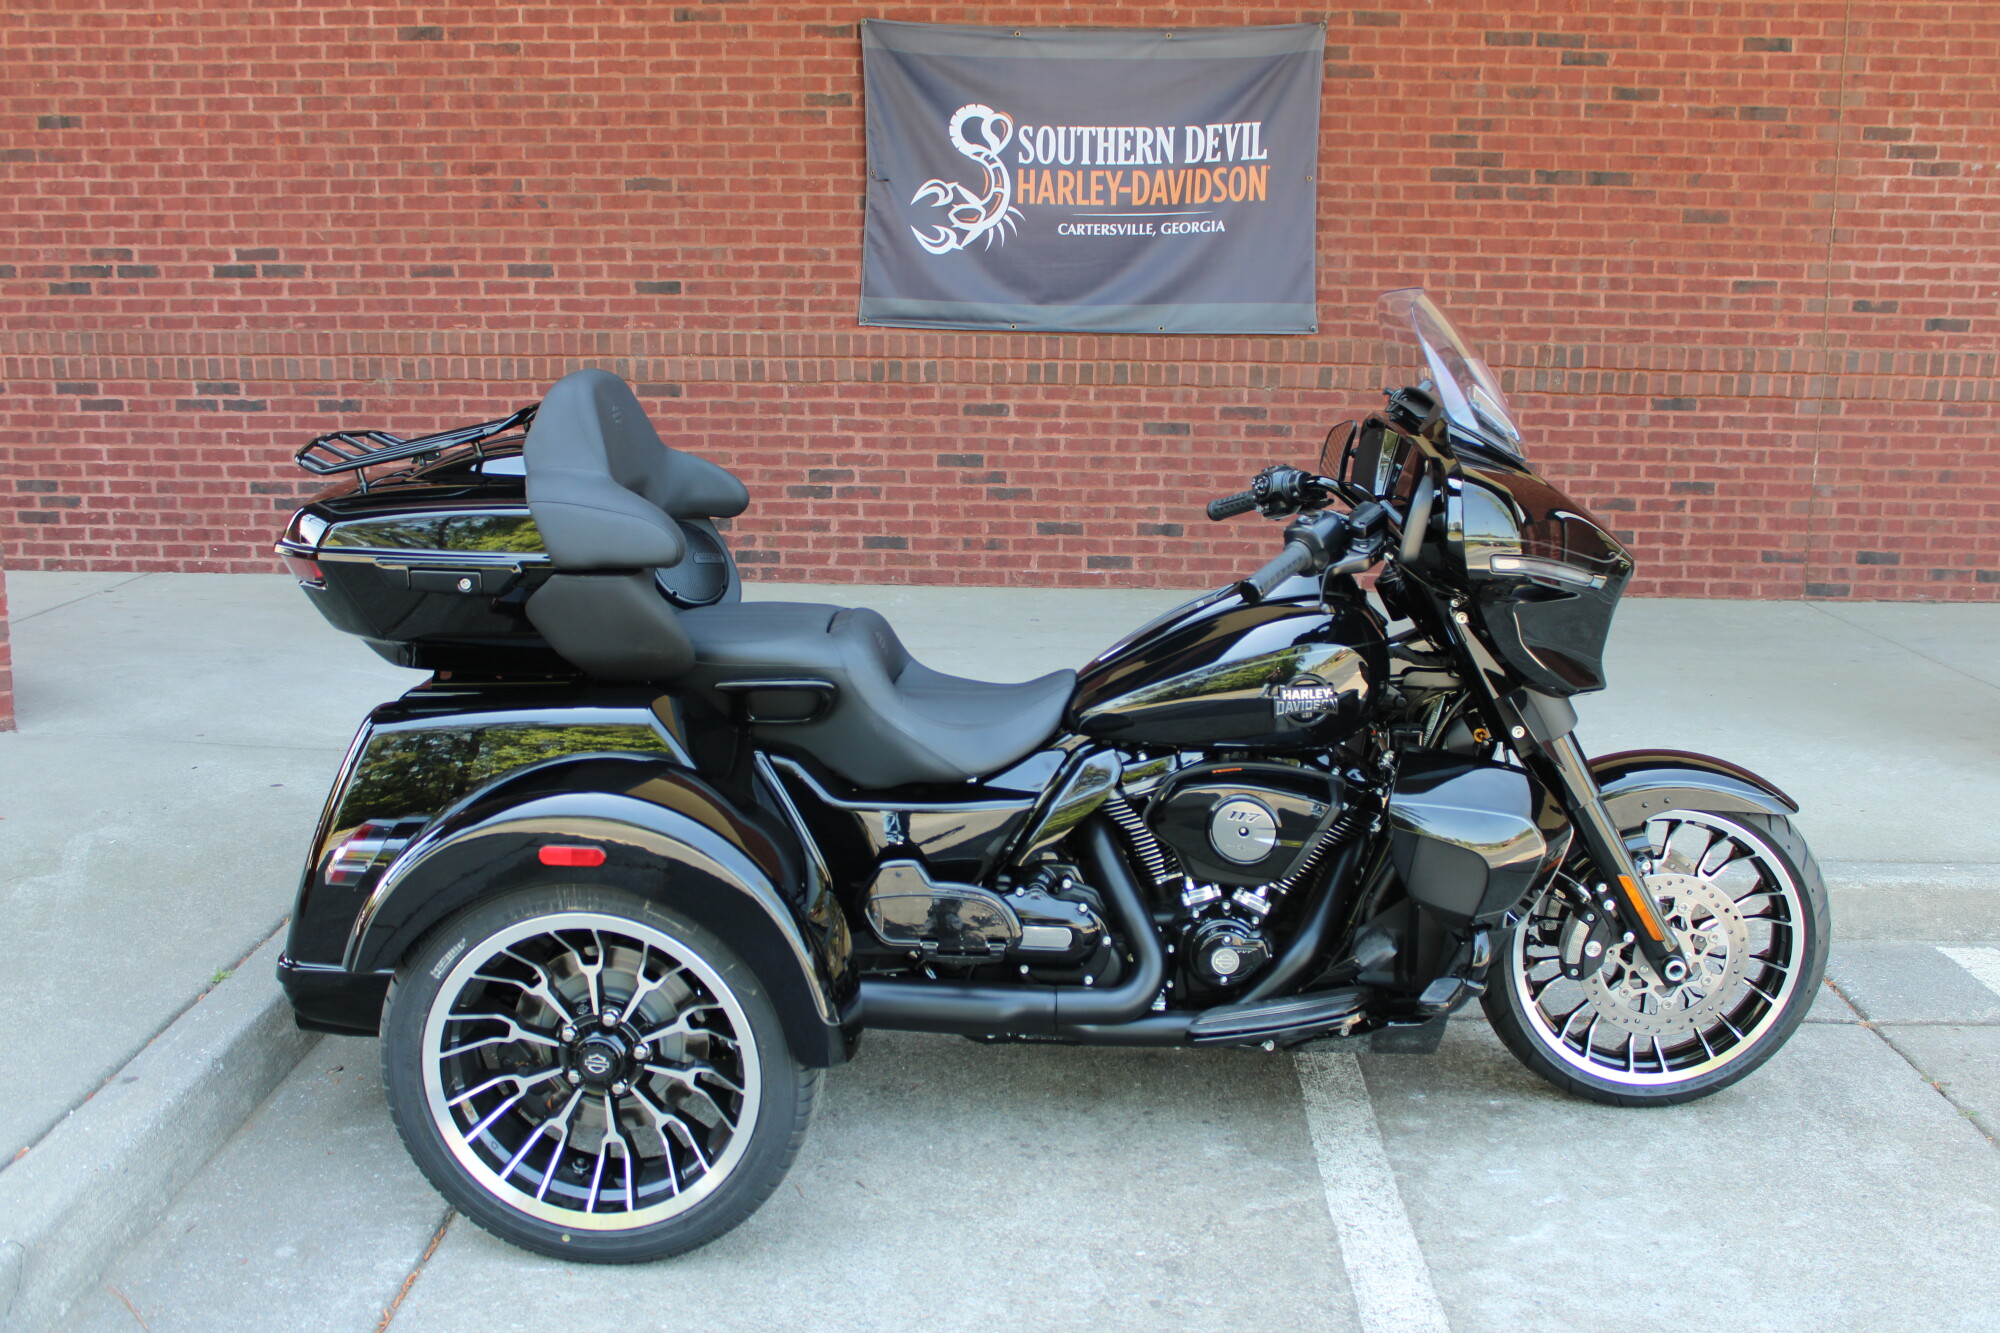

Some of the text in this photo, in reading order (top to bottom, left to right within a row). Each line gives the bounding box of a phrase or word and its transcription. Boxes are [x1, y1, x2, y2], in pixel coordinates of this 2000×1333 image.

[1018, 121, 1268, 165] SOUTHERN DEVIL
[1017, 165, 1268, 206] HARLEY-DAVIDSON
[1057, 220, 1226, 238] CARTERSVILLE, GEORGIA
[1281, 687, 1334, 701] HARLEY-
[1275, 697, 1339, 717] DAVIDSON
[1227, 810, 1262, 823] 117
